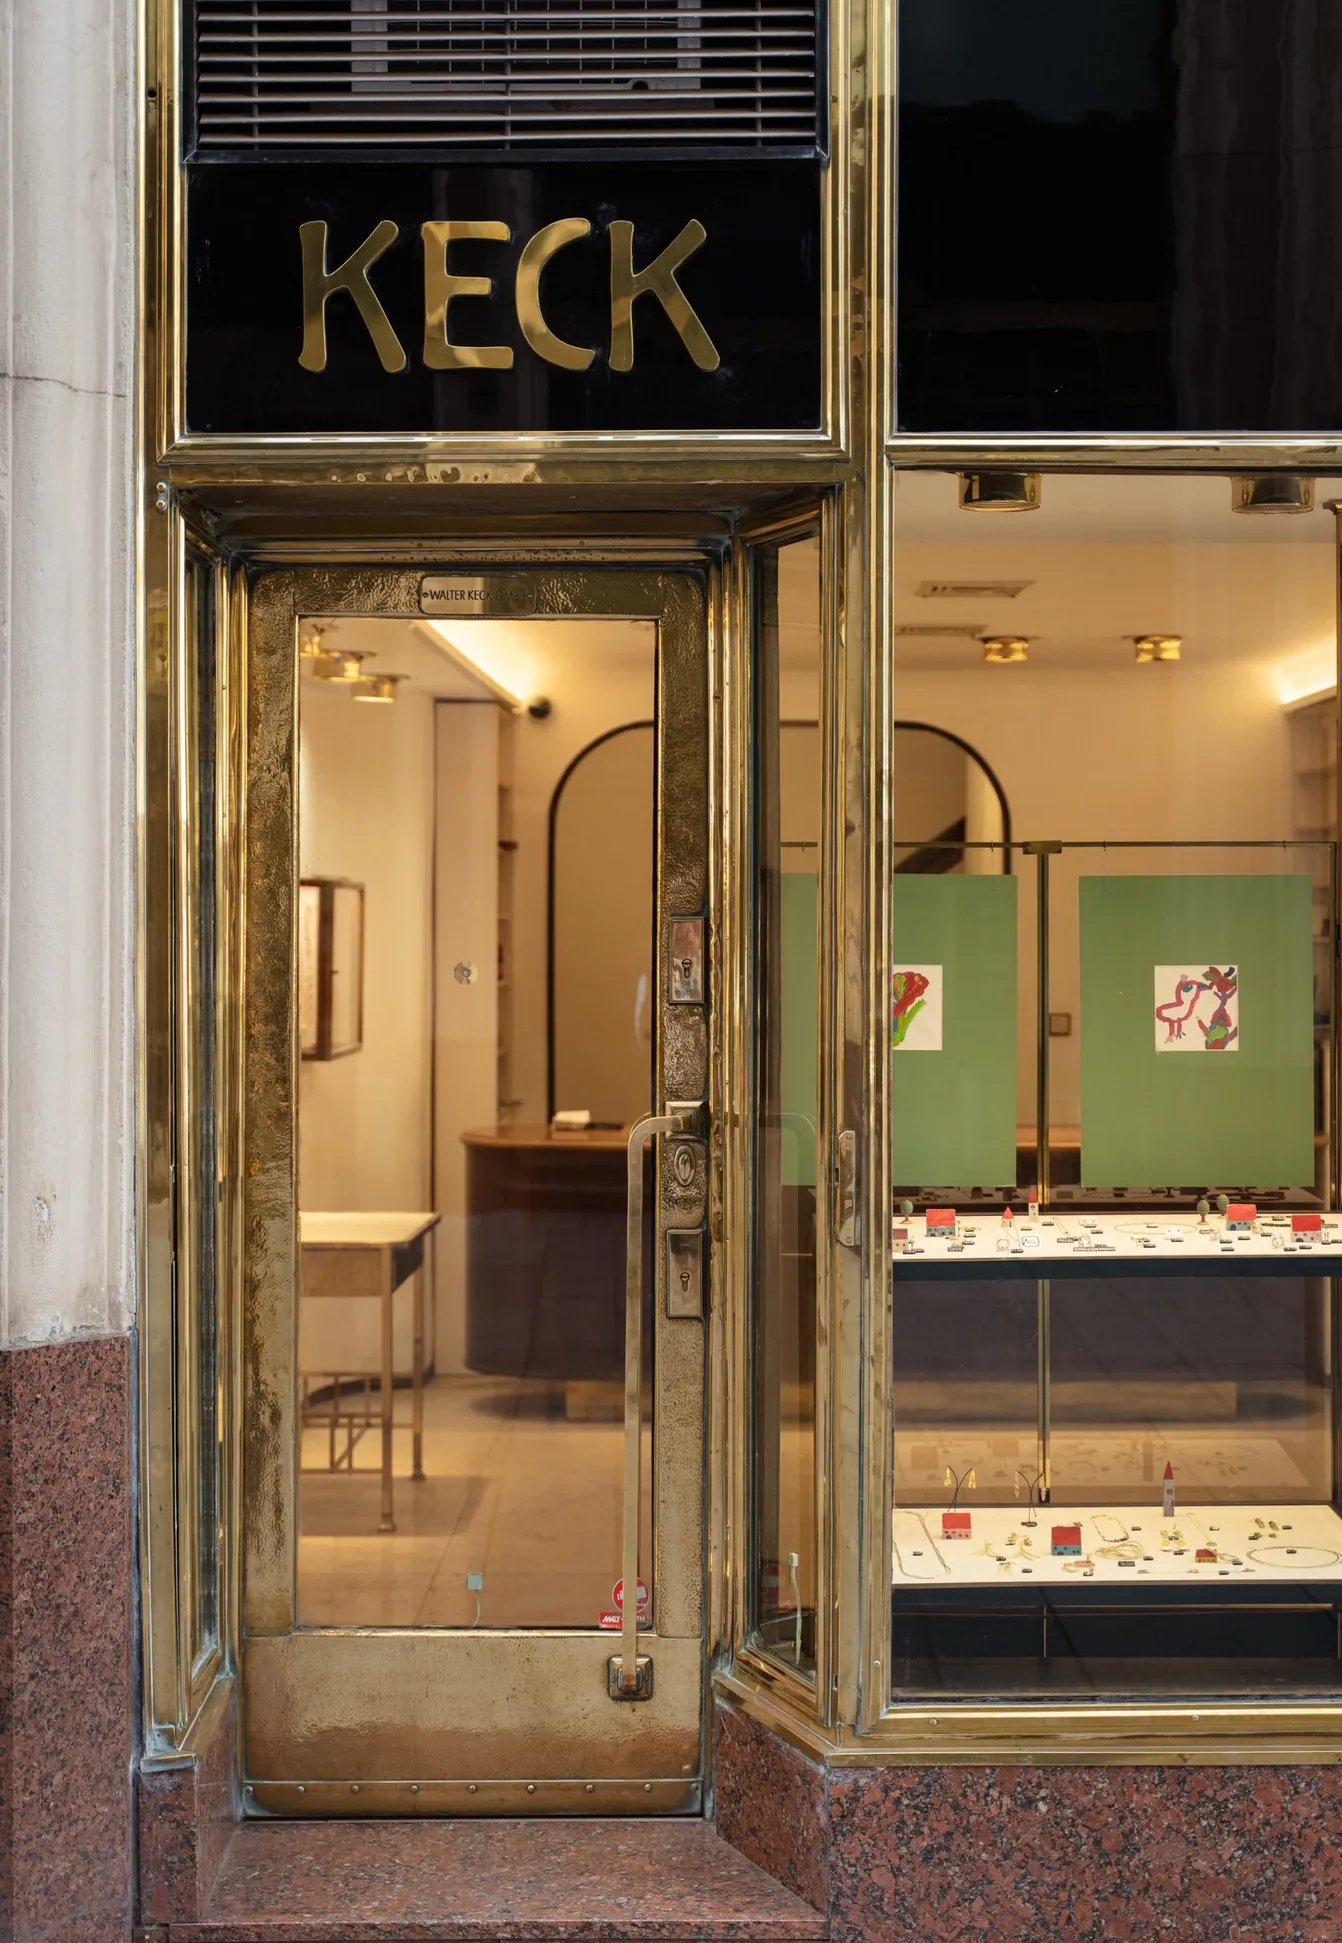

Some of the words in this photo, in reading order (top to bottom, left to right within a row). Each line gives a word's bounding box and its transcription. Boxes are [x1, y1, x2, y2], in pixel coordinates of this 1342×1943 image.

[298, 217, 720, 373] KECK
[428, 589, 466, 601] WALTER
[467, 589, 493, 601] KECK
